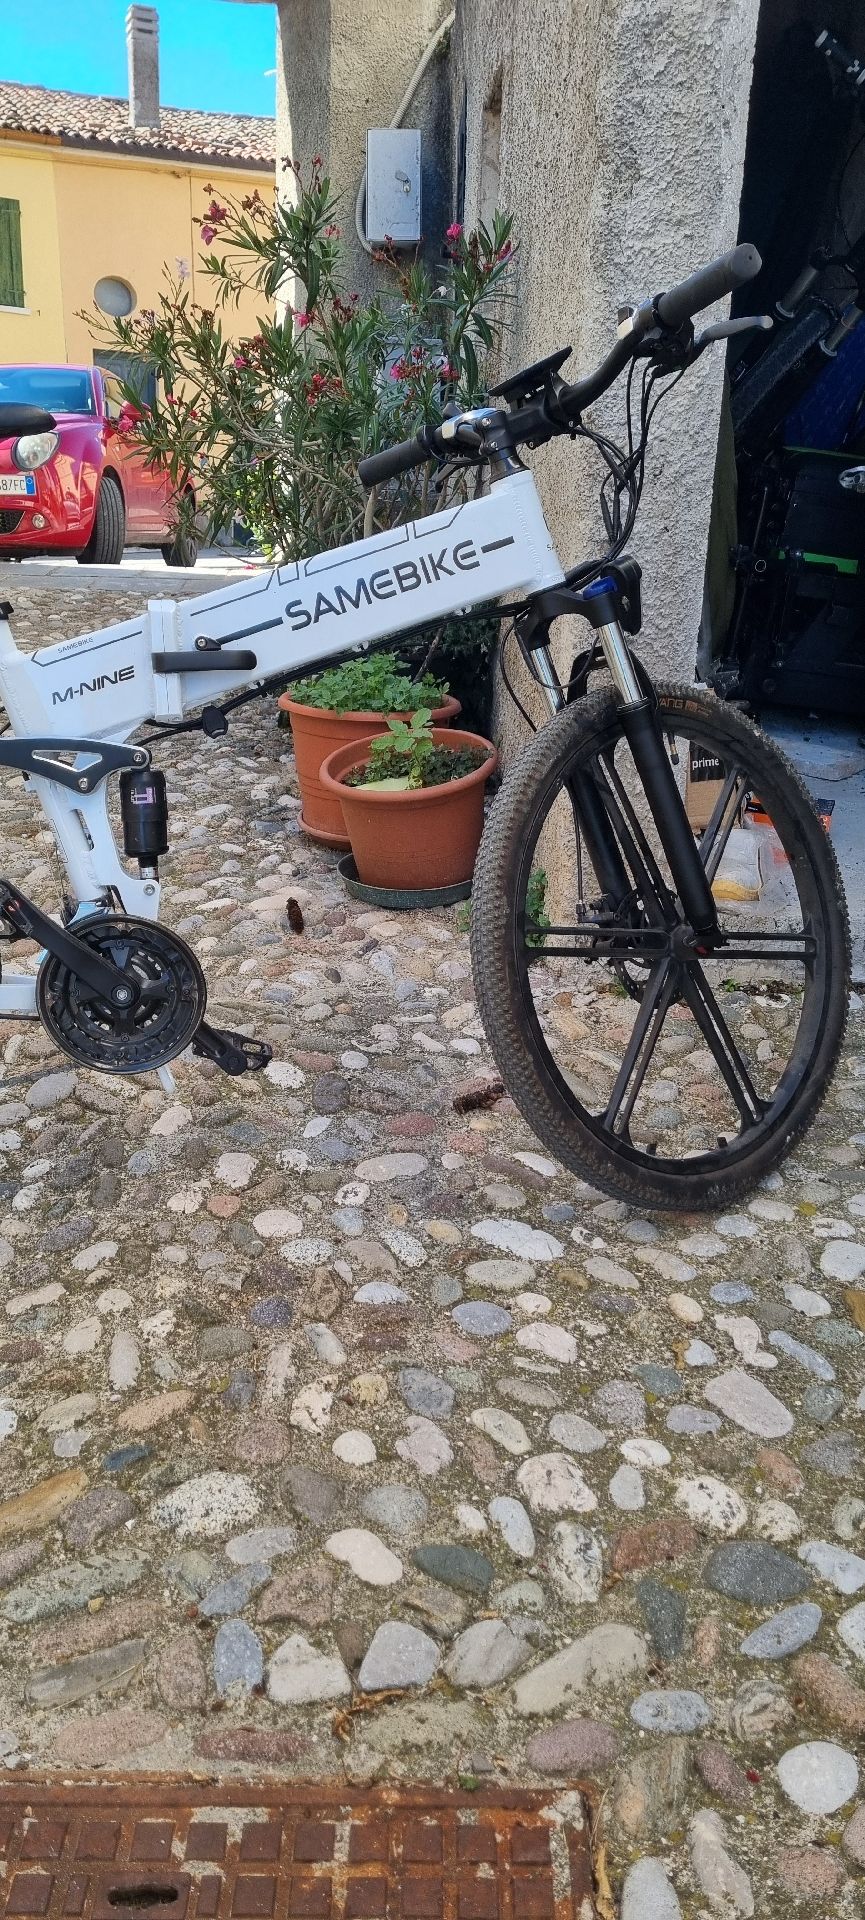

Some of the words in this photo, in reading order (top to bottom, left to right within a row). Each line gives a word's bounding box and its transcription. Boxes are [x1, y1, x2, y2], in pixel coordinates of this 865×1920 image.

[0, 479, 25, 491] 87FC
[285, 539, 480, 631] SAMEBIKE
[57, 637, 93, 653] SAMEBIKE
[52, 665, 135, 705] M-NINE
[692, 757, 719, 770] prime
